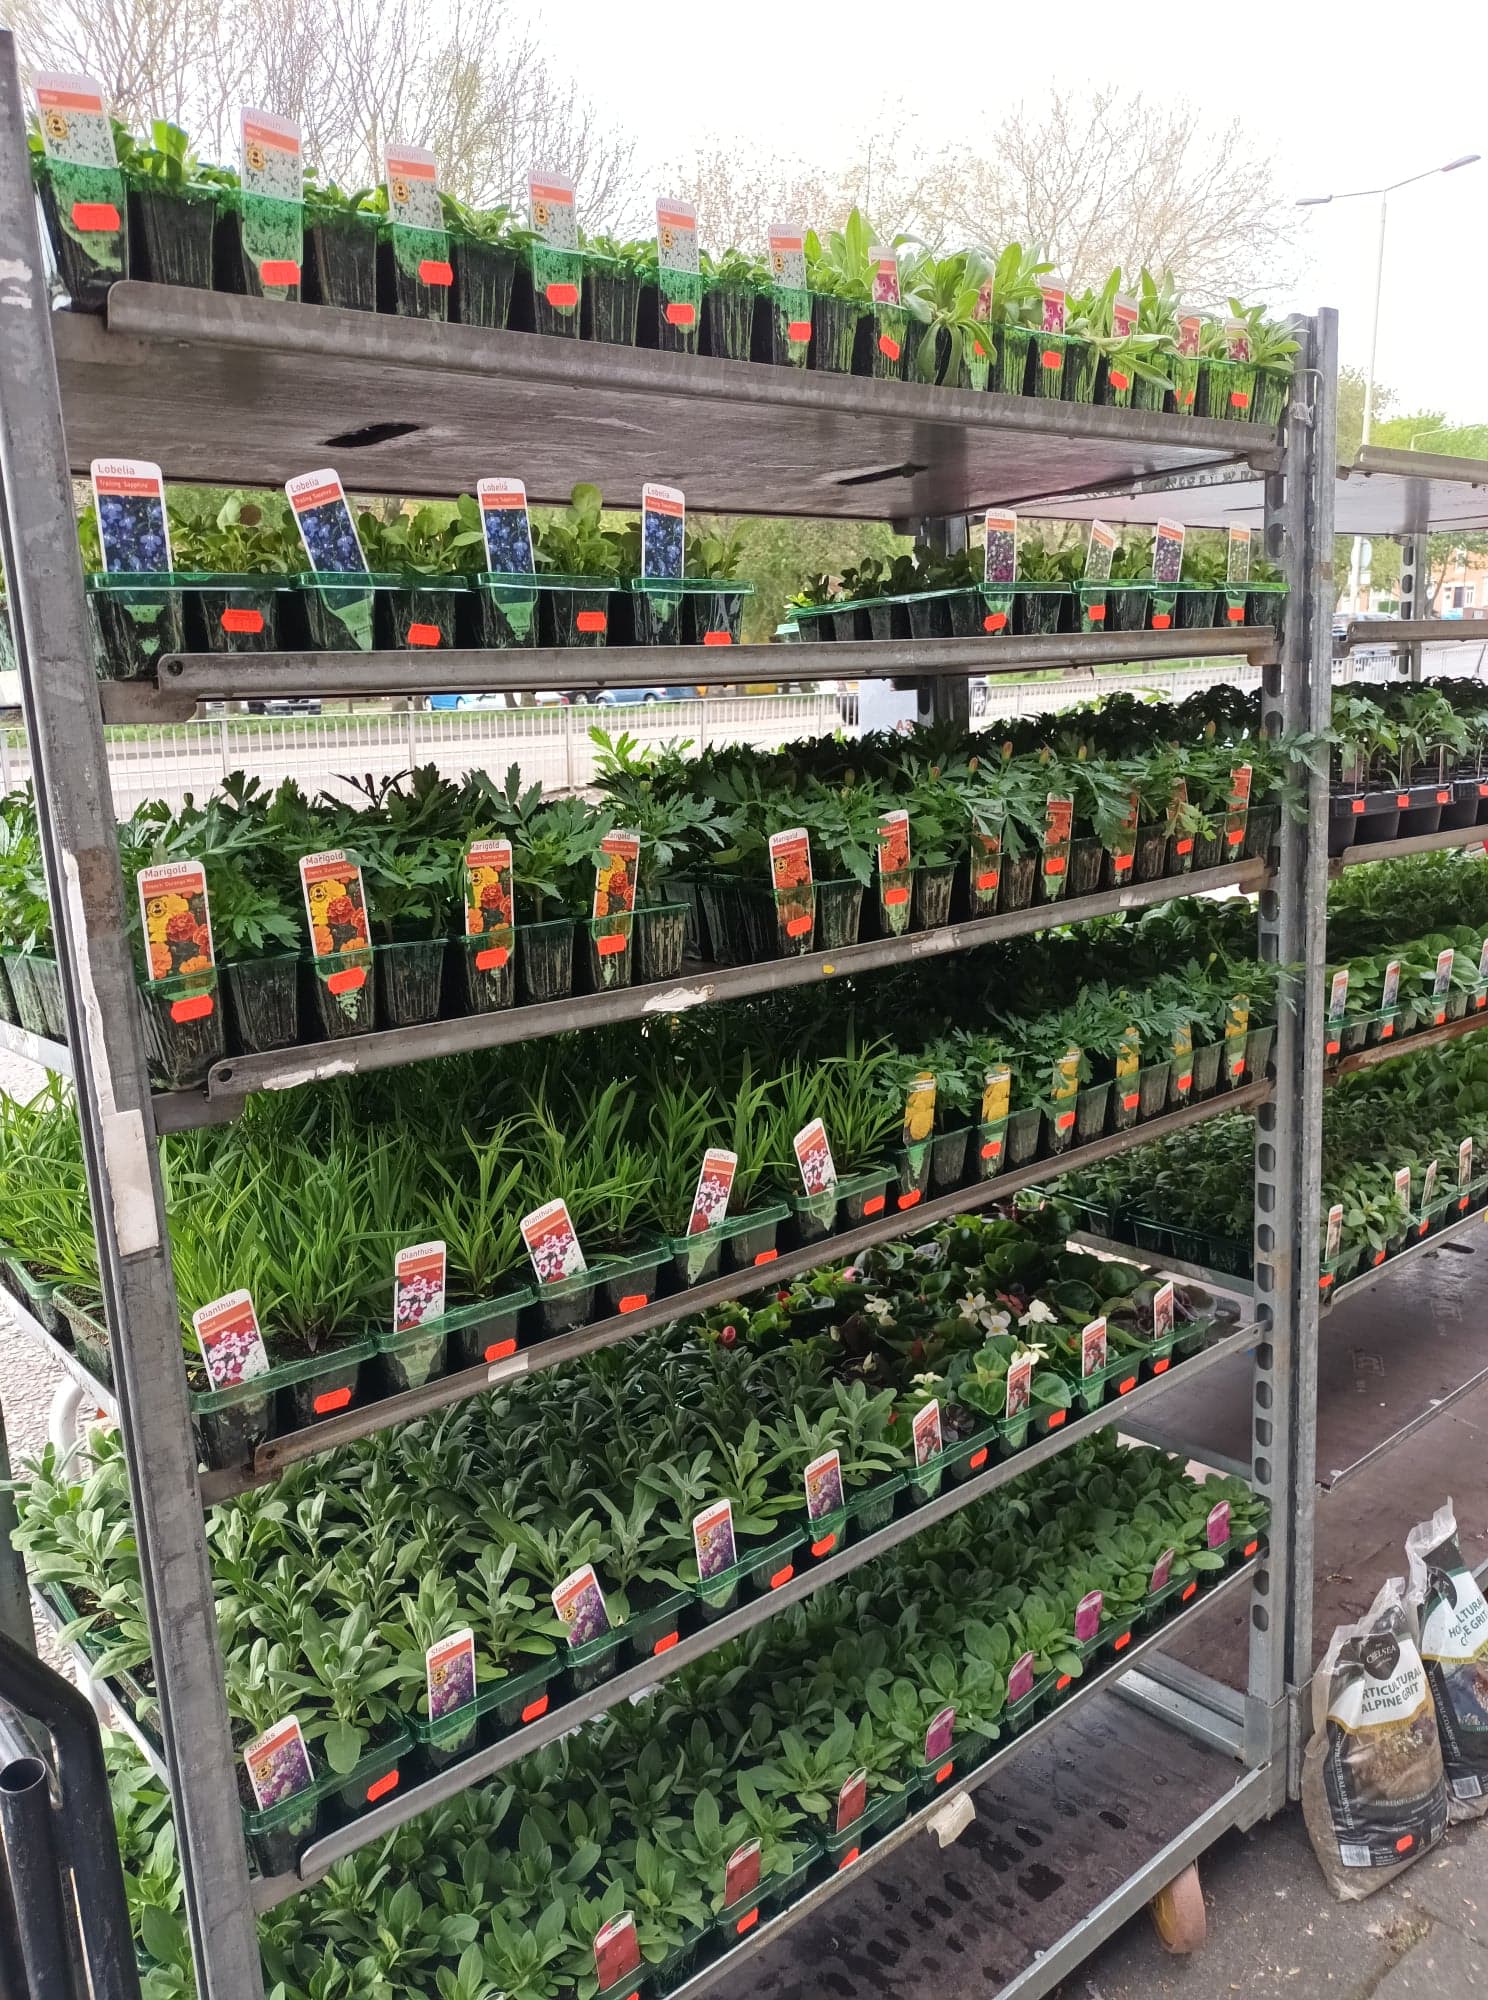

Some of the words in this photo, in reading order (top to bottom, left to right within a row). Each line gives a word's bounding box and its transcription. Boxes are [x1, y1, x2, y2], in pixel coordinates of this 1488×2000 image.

[97, 464, 135, 475] Lobelia
[290, 478, 320, 493] Lobelia
[482, 483, 508, 492] Lobelia
[647, 486, 670, 499] Lobelia
[607, 832, 631, 840] arigold
[773, 831, 798, 844] Marigold
[305, 851, 343, 865] Marigold
[144, 863, 187, 879] Marigold
[524, 1206, 554, 1227] Dianthus
[401, 1247, 433, 1260] Dianthus
[199, 1299, 237, 1320] Dianthus
[555, 1577, 577, 1596] Stocks
[1470, 1610, 1488, 1629] GRIT
[431, 1640, 455, 1656] Stocks
[1362, 1666, 1422, 1700] RTICULTURAL
[1361, 1695, 1403, 1714] ALPINE
[1401, 1682, 1419, 1701] GRIT
[248, 1732, 276, 1753] Stocks
